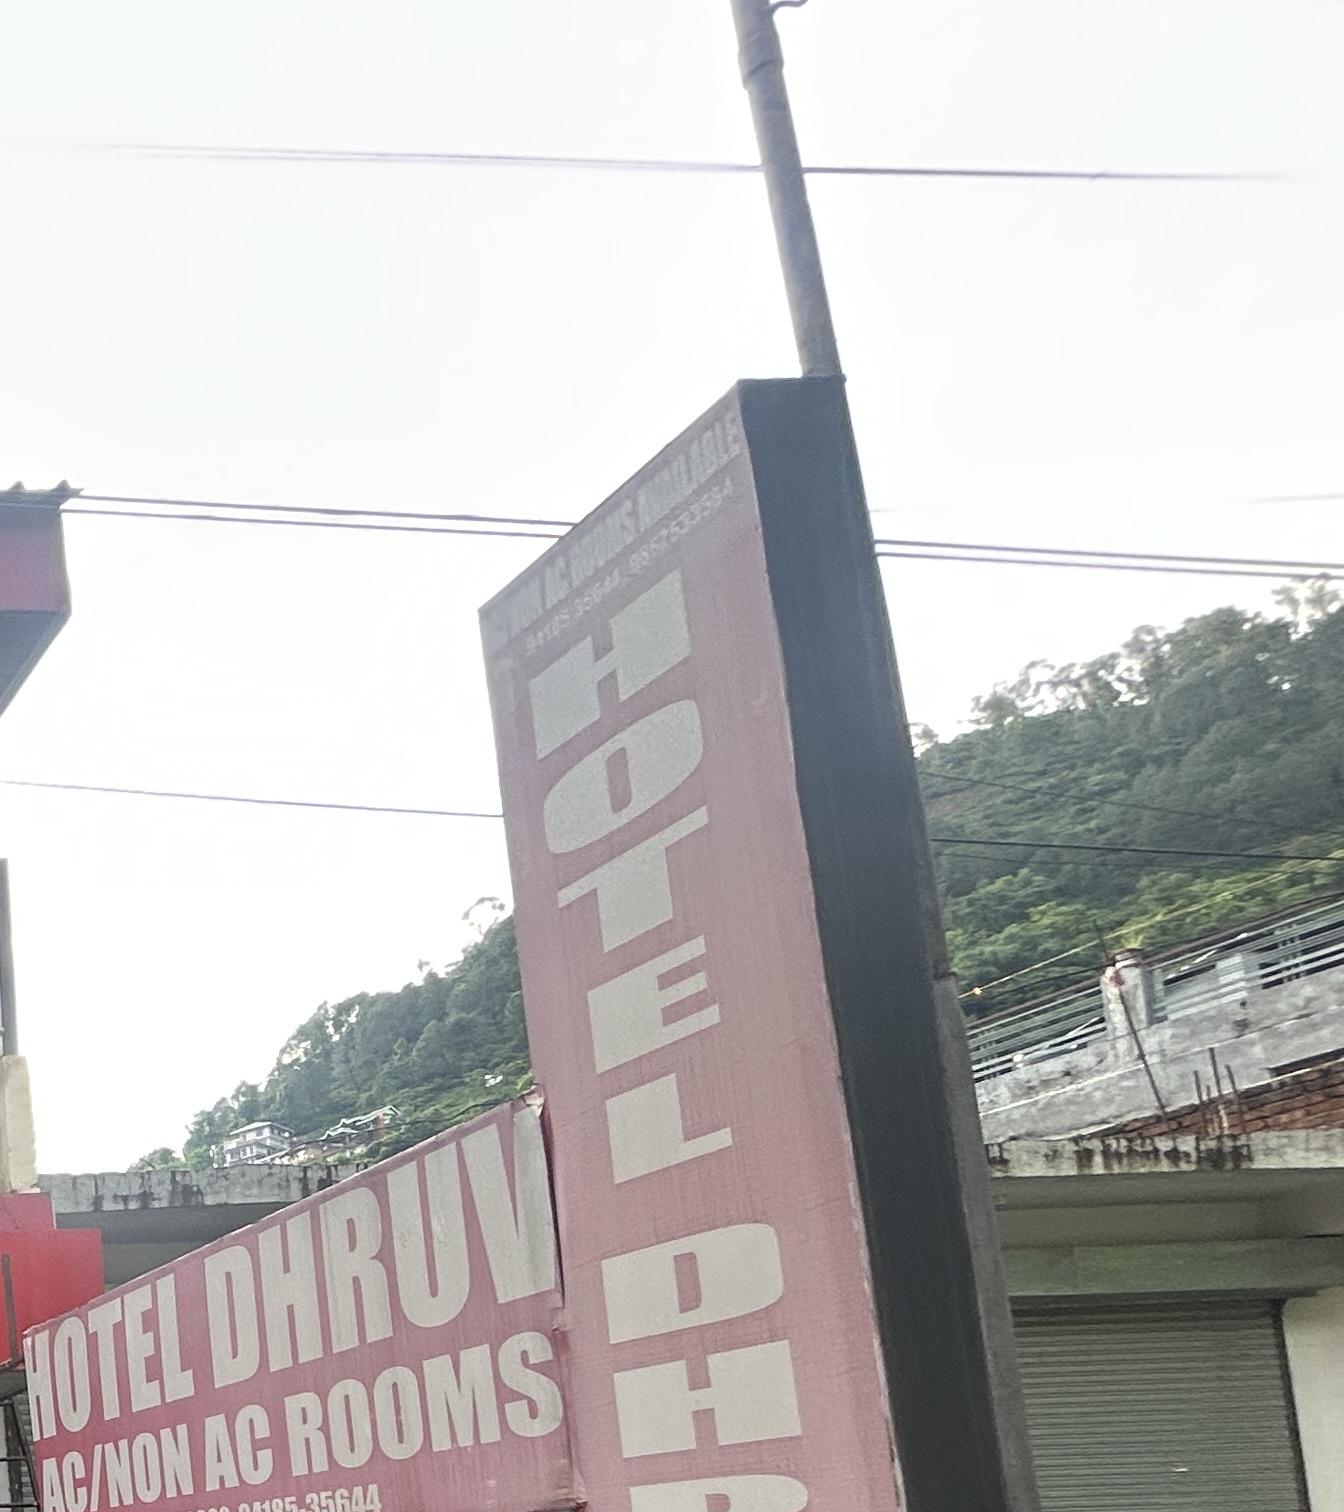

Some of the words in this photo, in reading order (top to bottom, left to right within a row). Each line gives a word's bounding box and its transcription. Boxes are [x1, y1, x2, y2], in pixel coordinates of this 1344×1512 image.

[528, 567, 733, 1184] HOTEL
[23, 1273, 195, 1443] HOTEL
[203, 1104, 557, 1389] DHRUV
[205, 1404, 274, 1492] AC
[283, 1330, 565, 1478] ROOMS
